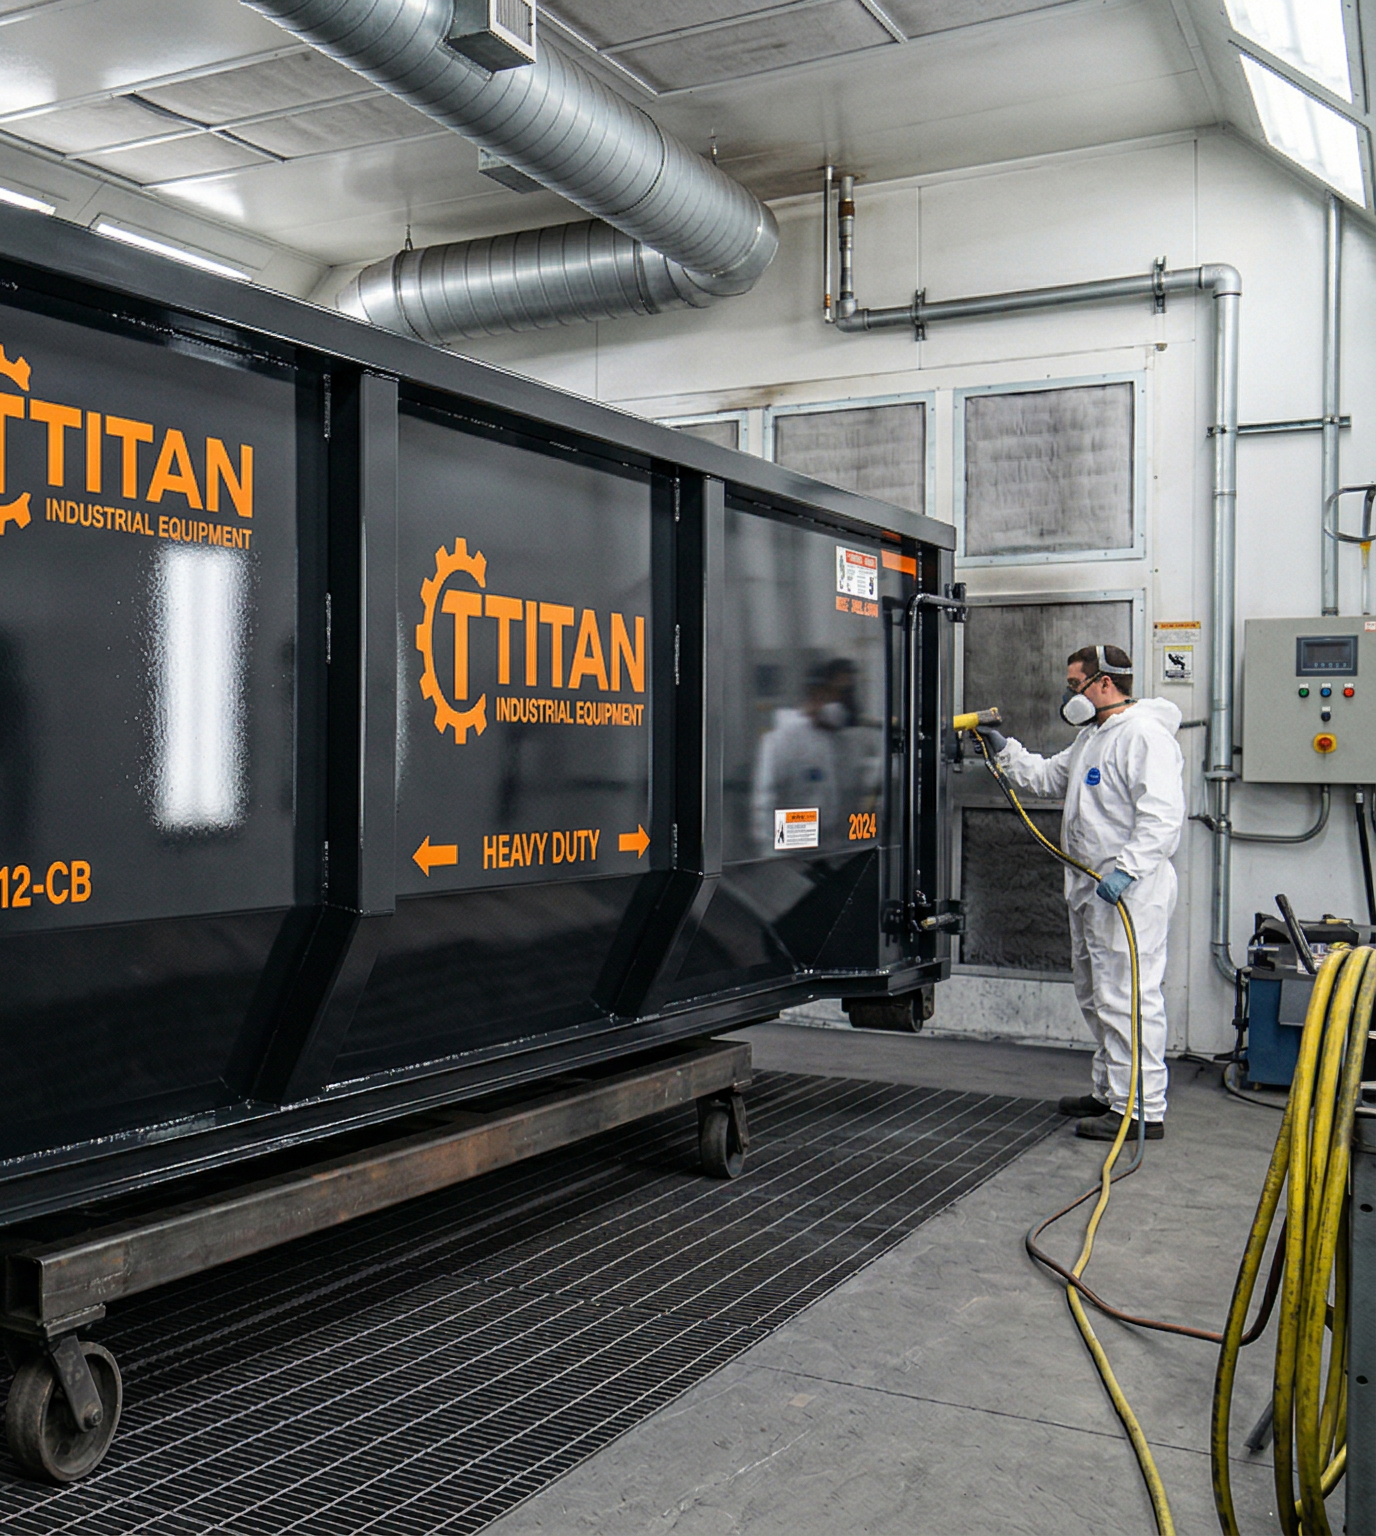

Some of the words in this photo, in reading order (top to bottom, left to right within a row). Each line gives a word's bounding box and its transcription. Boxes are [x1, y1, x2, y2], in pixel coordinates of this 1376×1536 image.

[29, 398, 254, 519] TITAN
[45, 497, 155, 536] INDUSTRIAL
[158, 515, 253, 550] EQUIPMENT
[485, 594, 645, 693] TITAN
[496, 697, 574, 724] INDUSTRIAL
[576, 701, 644, 726] EQUIPMENT
[483, 832, 548, 870] HEAVY
[552, 829, 601, 864] DUTY
[848, 812, 877, 840] 2024
